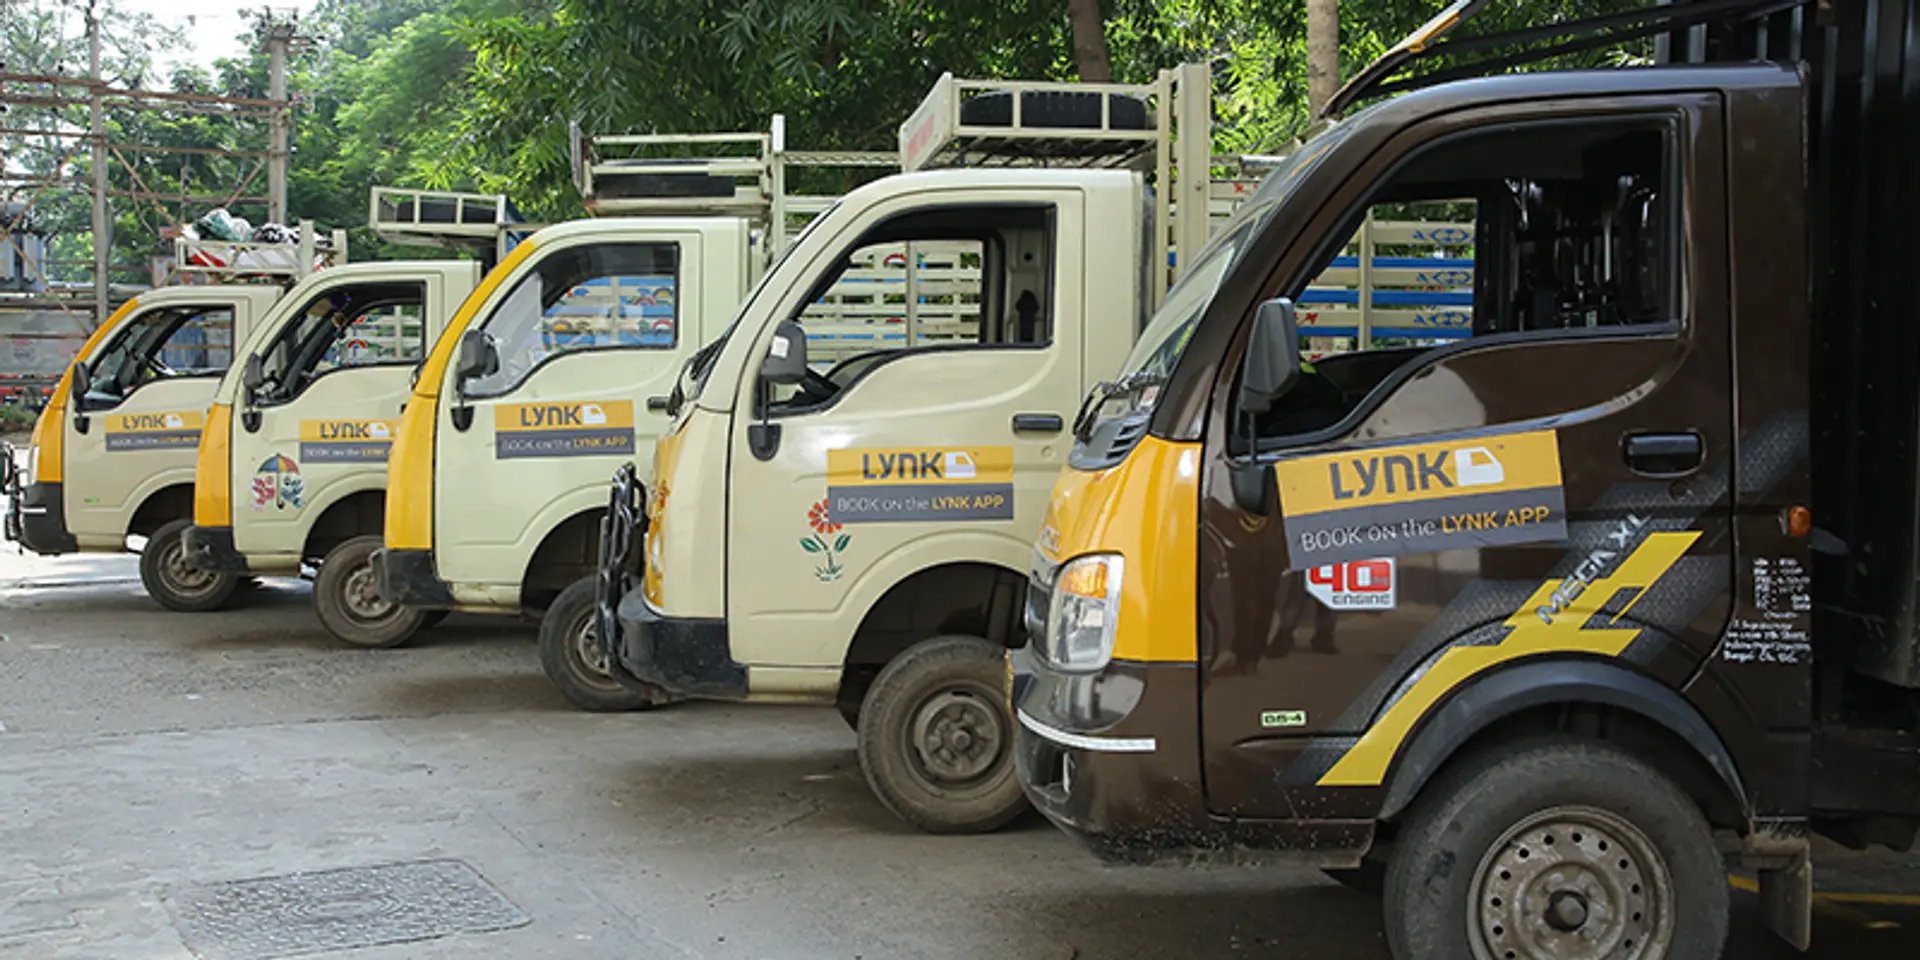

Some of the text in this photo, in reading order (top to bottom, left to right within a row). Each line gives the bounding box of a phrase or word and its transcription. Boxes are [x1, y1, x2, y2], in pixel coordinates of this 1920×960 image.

[520, 405, 581, 426] LYNK
[862, 452, 943, 479] LYNK
[1329, 450, 1453, 500] LYNK
[837, 497, 879, 513] BOOK
[905, 496, 929, 511] the
[931, 496, 970, 510] LYNK
[973, 494, 1004, 509] APP
[1300, 525, 1363, 552] BOOK
[1401, 519, 1436, 537] the
[1441, 514, 1498, 534] LYNK
[1504, 505, 1551, 529] APP
[1535, 514, 1652, 625] MEGA XL
